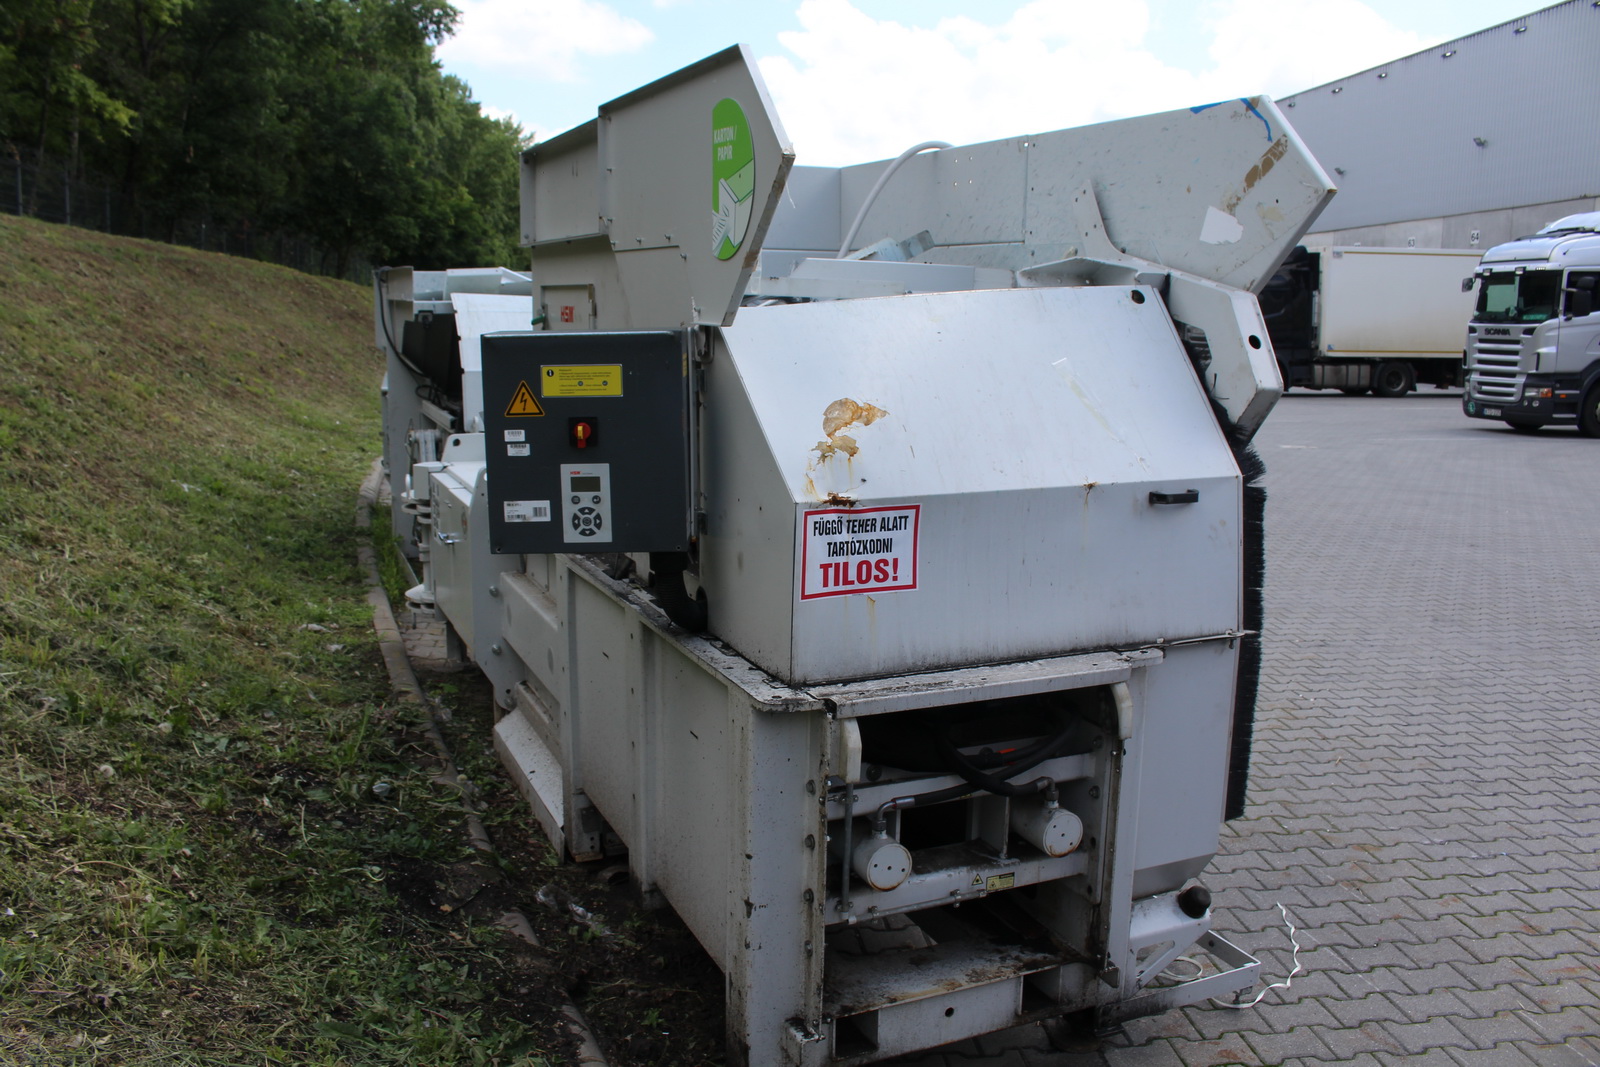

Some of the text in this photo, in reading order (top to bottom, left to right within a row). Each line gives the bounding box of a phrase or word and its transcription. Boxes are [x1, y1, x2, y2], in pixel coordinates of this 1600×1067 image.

[1471, 232, 1479, 242] 64
[1484, 328, 1510, 336] SCANIA
[813, 515, 909, 537] FÜGGŐ TEHER ALATT
[827, 537, 893, 557] TARTÓZKODNI
[819, 558, 899, 588] TILOS!
